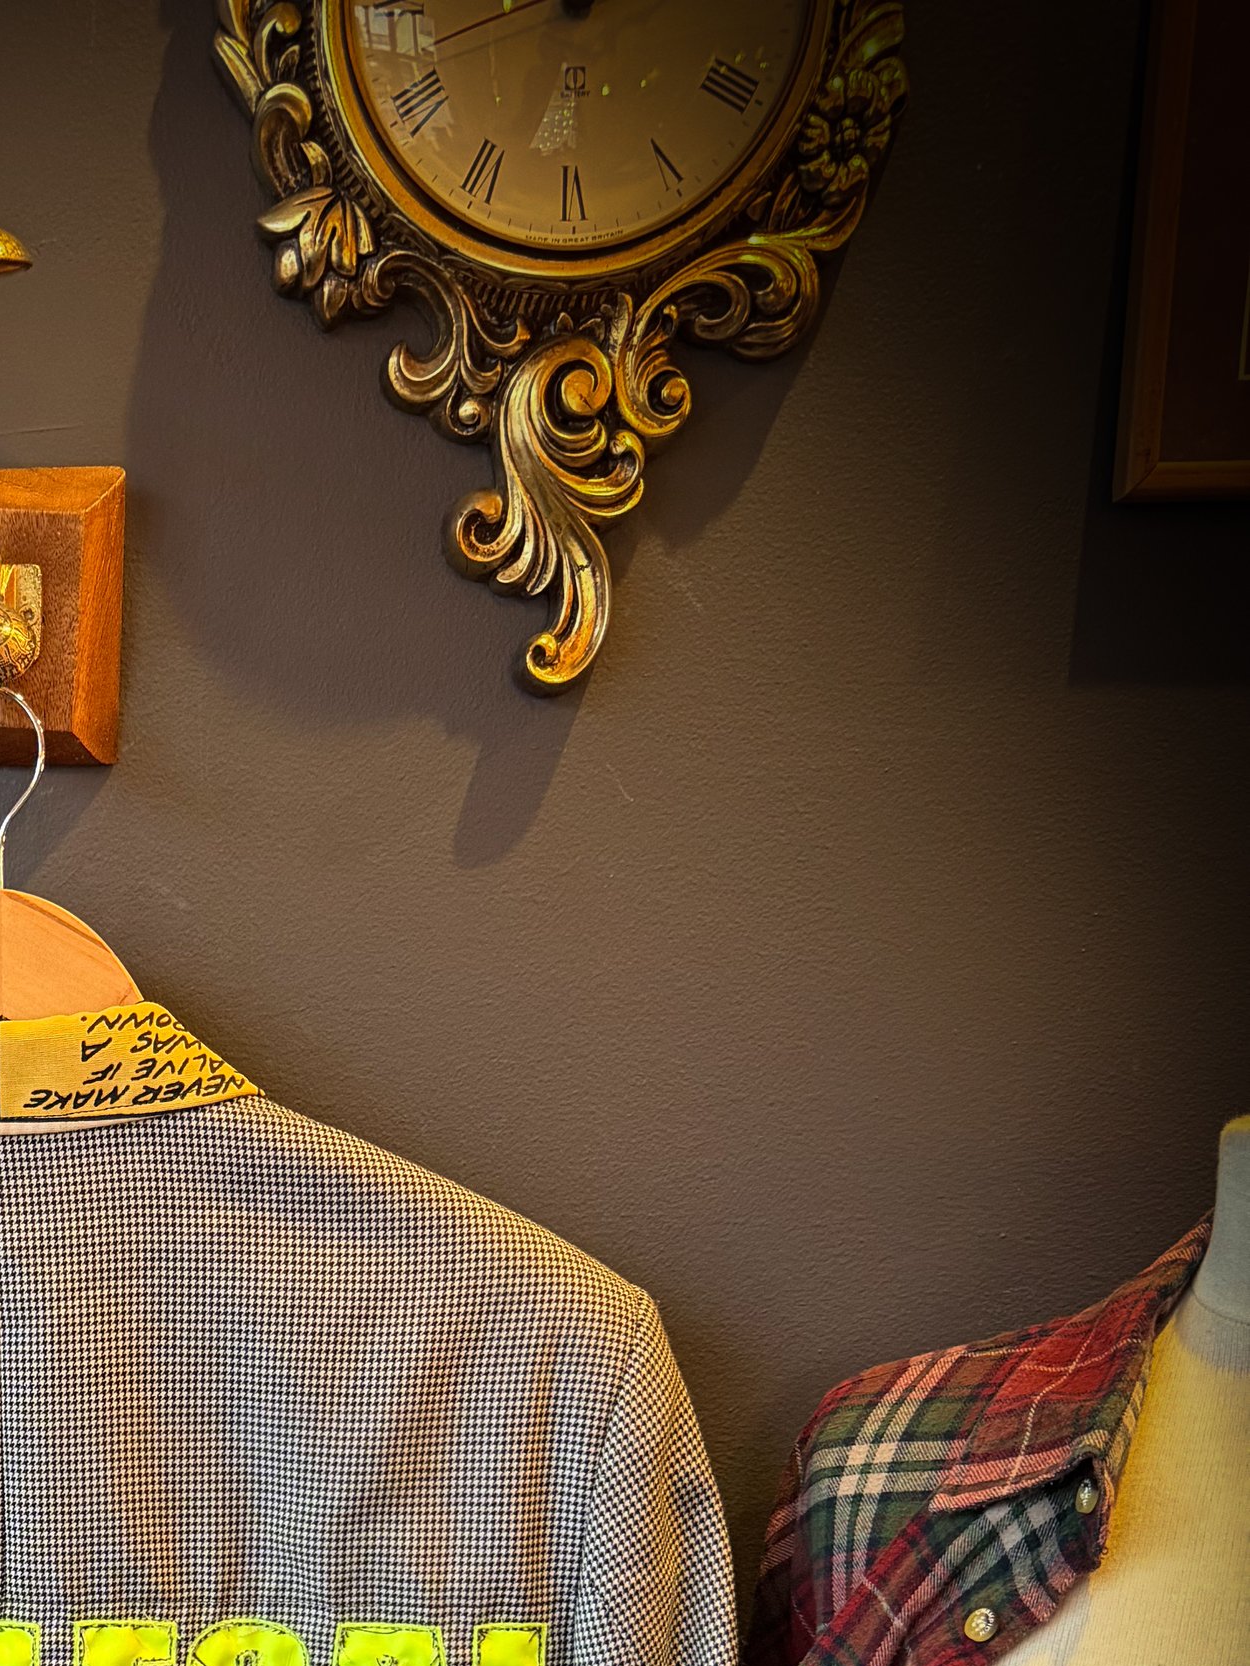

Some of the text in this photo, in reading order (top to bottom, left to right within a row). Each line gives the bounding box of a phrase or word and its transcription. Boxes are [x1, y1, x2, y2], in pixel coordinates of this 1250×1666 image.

[562, 236, 589, 244] GREAT
[591, 229, 624, 241] BRITAIN
[81, 1031, 202, 1062] WAS A
[83, 1054, 225, 1085] ALIVE IF
[23, 1074, 245, 1110] NEVER MAKE
